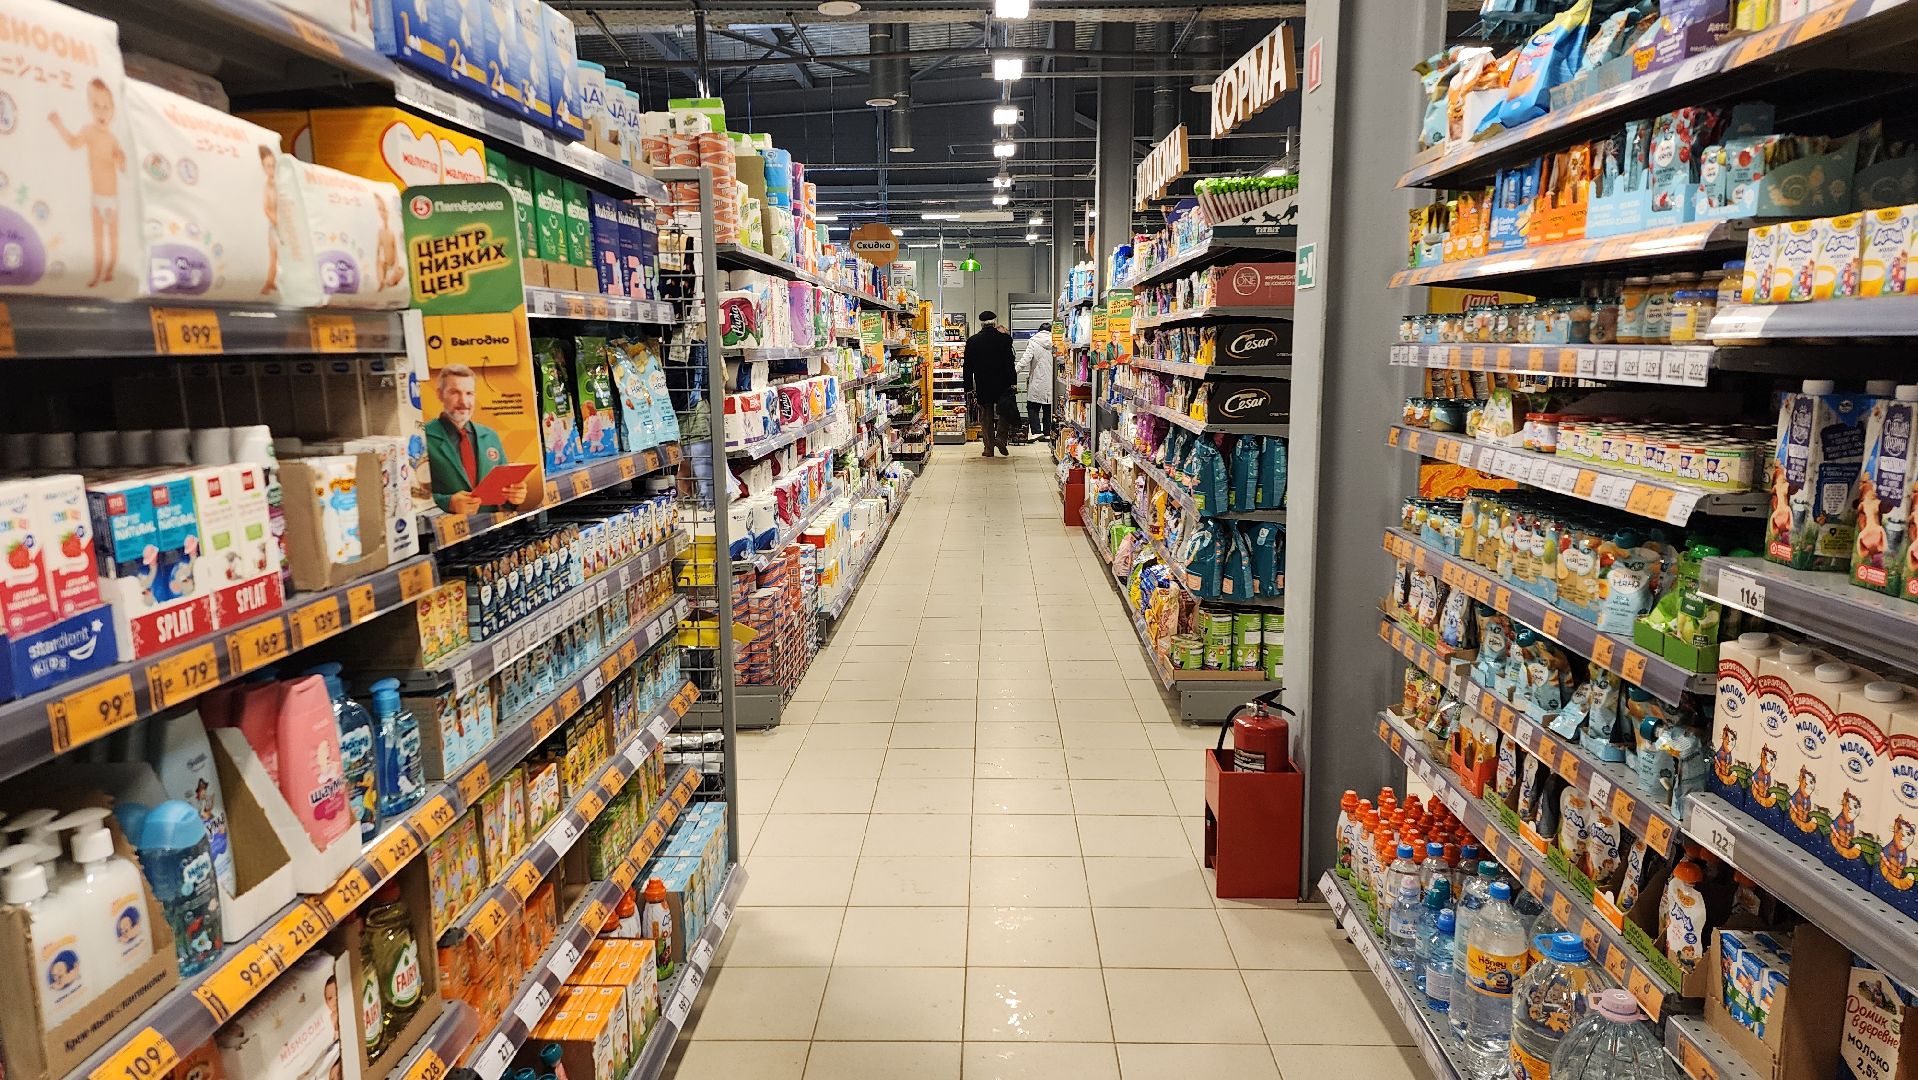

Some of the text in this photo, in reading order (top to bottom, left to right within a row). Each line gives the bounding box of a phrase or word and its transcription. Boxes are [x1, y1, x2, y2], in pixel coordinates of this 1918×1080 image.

[449, 38, 462, 71] 2
[489, 60, 500, 91] 2
[1210, 24, 1287, 140] КОРМА
[434, 200, 504, 214] Пятёрочка
[417, 230, 486, 258] ЦЕНТР
[856, 241, 891, 249] Скидка
[419, 243, 507, 276] НИЗКИХ
[151, 257, 176, 290] 5
[420, 272, 463, 294] ЦЕН
[181, 325, 211, 344] 899
[451, 336, 510, 347] Выгодно
[1231, 334, 1274, 354] Cesar
[1624, 361, 1636, 373] 129
[1645, 361, 1656, 373] 129
[1668, 362, 1680, 374] 144
[1690, 363, 1704, 376] 202
[1224, 392, 1267, 413] Cesar
[235, 582, 268, 615] SPLAT
[1740, 587, 1758, 607] 116
[156, 605, 195, 644] SPLAT
[254, 633, 279, 657] 169
[182, 662, 209, 687] 179
[99, 695, 122, 721] 99
[430, 806, 449, 826] 199
[389, 837, 411, 863] 269
[1712, 830, 1729, 853] 122
[337, 878, 361, 904] 219
[489, 911, 502, 926] 24
[288, 920, 316, 946] 218
[566, 947, 577, 963] 27
[1478, 955, 1507, 969] Honey
[239, 961, 263, 986] 99
[396, 964, 418, 993] FAIRY
[535, 990, 548, 1007] 27
[1847, 995, 1889, 1029] Домик
[1852, 1014, 1900, 1049] в деревне
[125, 1046, 161, 1080] 109
[497, 1043, 510, 1062] 27
